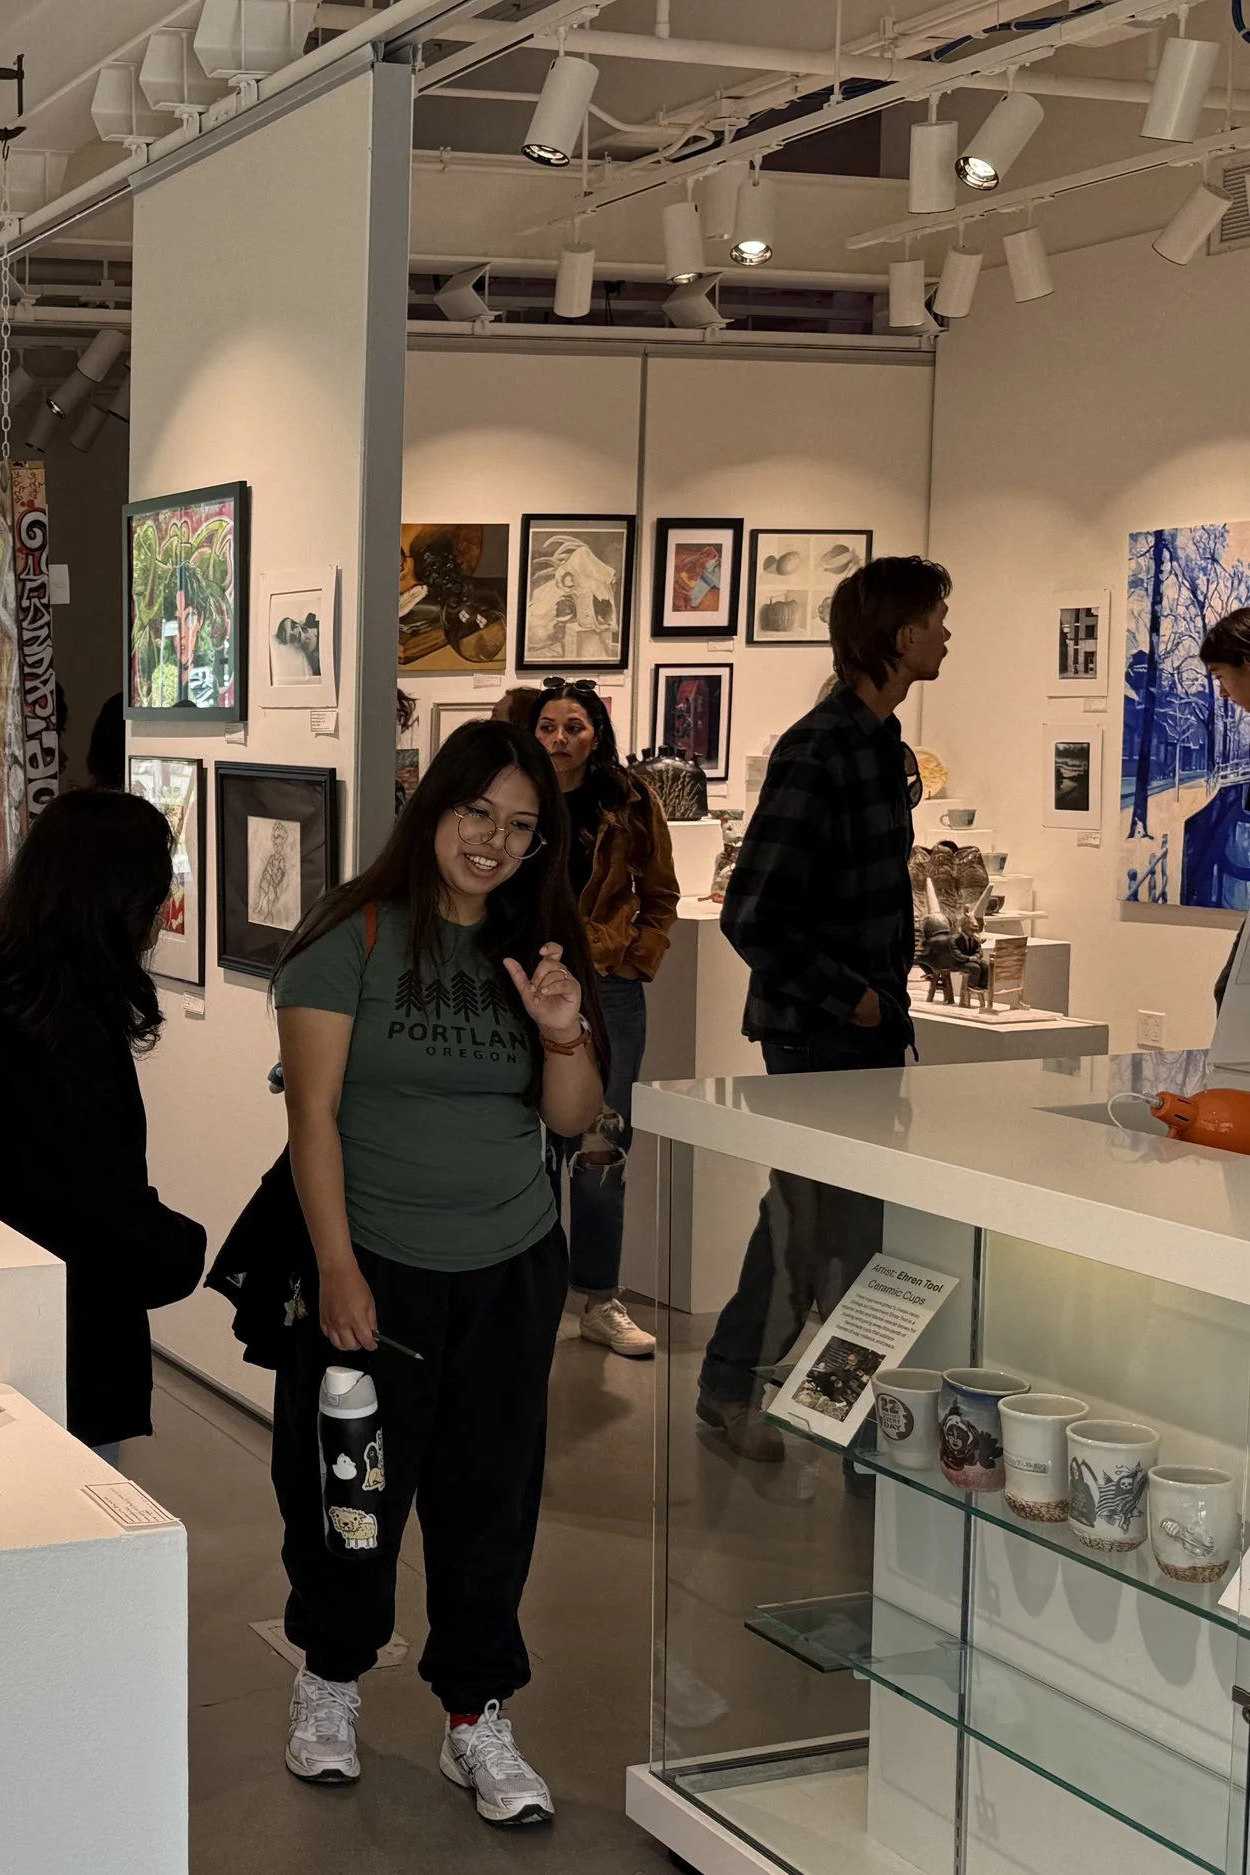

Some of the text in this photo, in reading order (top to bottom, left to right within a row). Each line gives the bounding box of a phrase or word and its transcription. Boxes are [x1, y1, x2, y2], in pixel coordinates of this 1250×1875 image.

[387, 1021, 527, 1051] PORTLAN
[426, 1046, 517, 1064] OREGON
[872, 1264, 944, 1293] Artist: Ehren Tool
[867, 1279, 903, 1297] Ceramic
[902, 1291, 926, 1305] Cups
[881, 1397, 900, 1414] 22
[883, 1422, 902, 1430] DAY
